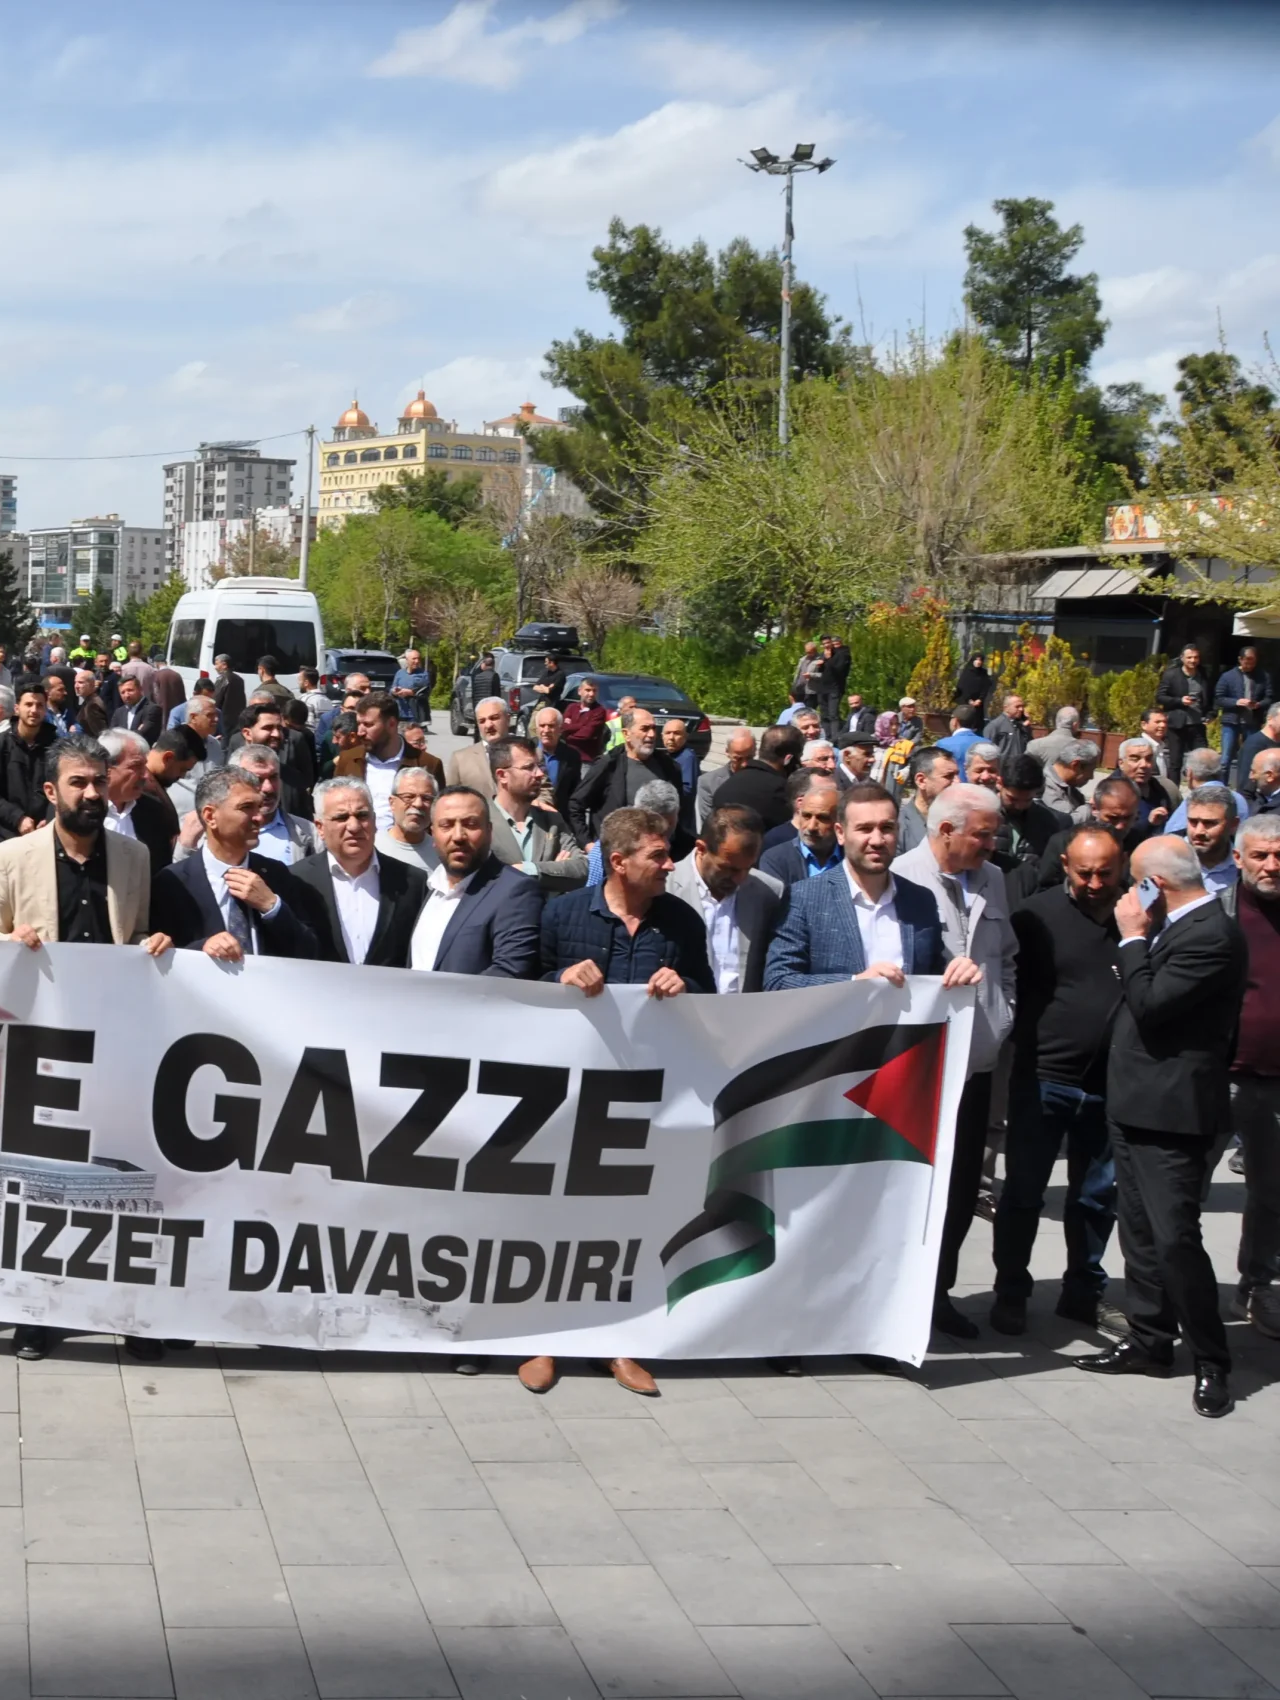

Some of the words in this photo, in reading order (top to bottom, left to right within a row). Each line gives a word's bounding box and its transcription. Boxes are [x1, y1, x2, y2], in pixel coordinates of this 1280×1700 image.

[152, 1032, 665, 1197] GAZZE
[1, 1180, 205, 1288] İZZET
[228, 1220, 642, 1304] DAVASIDIR!
